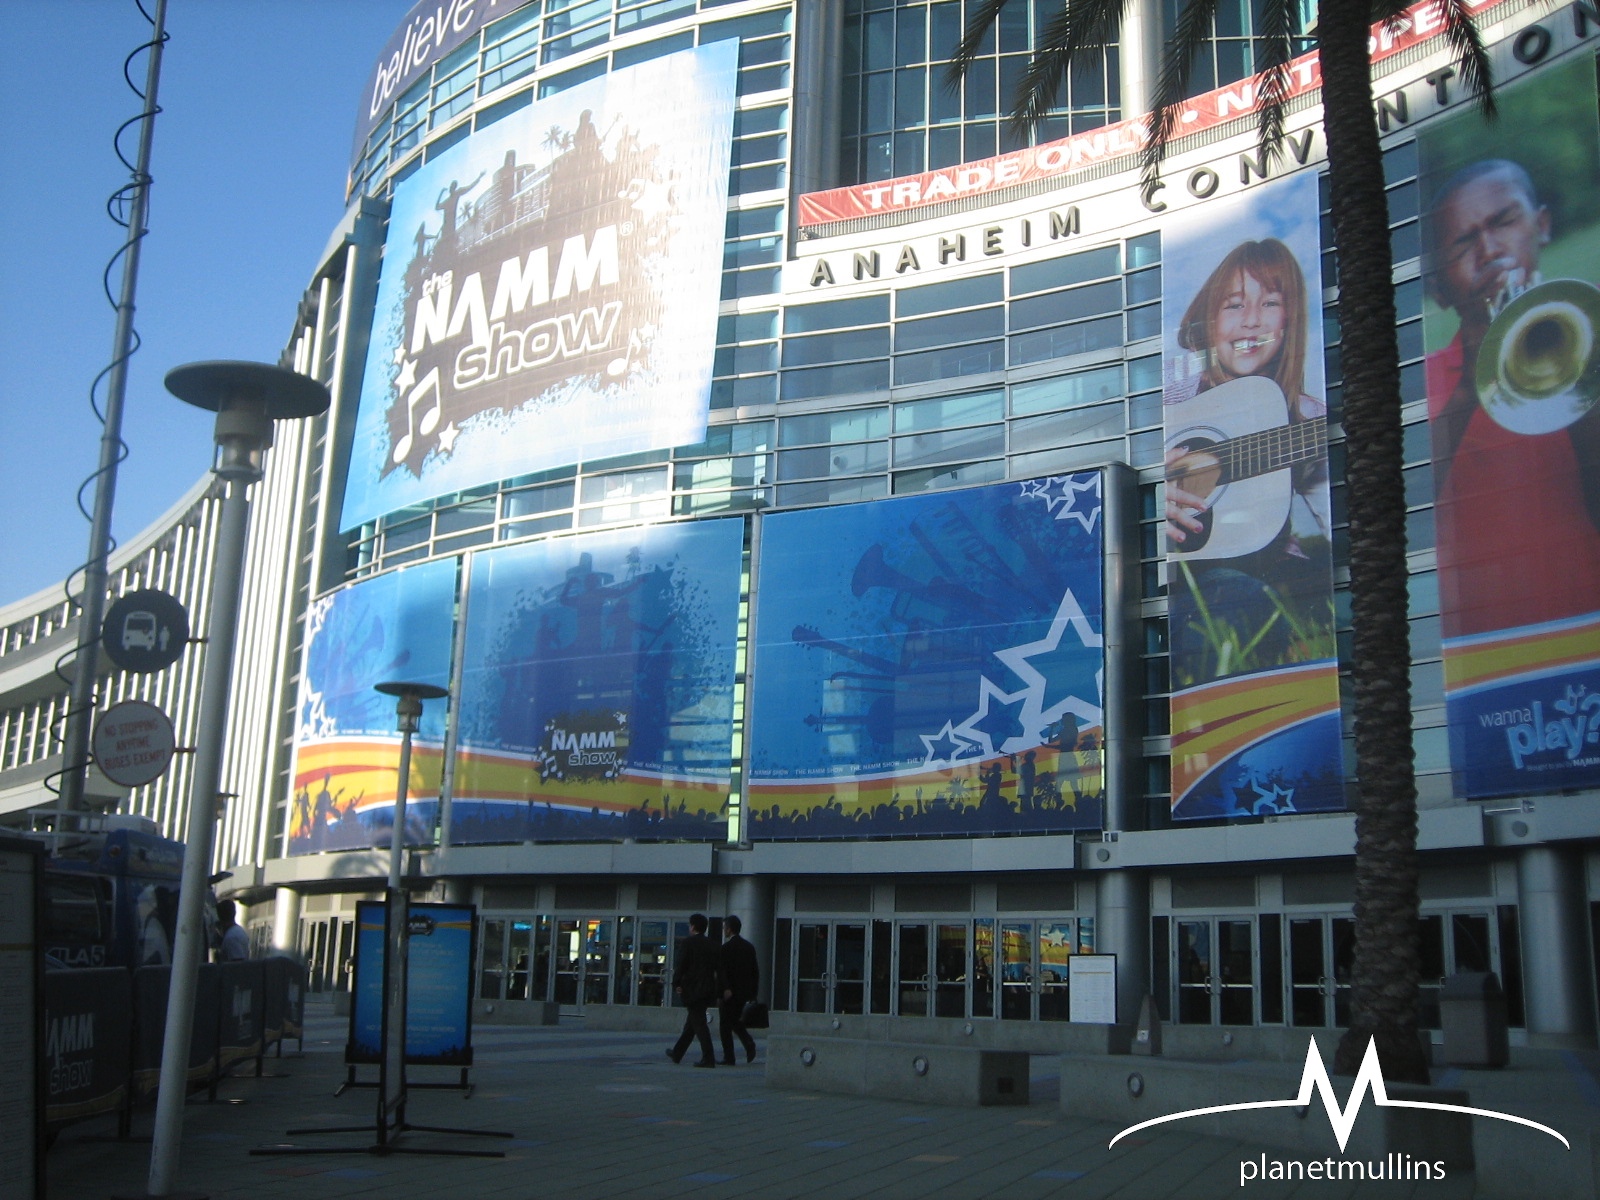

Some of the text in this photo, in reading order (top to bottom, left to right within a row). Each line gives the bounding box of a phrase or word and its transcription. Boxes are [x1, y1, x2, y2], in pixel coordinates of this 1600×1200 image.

[369, 0, 475, 120] believe
[809, 0, 1600, 287] ANAHEIM CONVNTON
[863, 157, 1022, 210] TRADE
[422, 269, 453, 298] the
[454, 301, 622, 390] show
[104, 725, 116, 737] NO
[1480, 708, 1533, 728] wanna
[551, 730, 616, 757] NAMM
[569, 750, 617, 766] show
[906, 757, 919, 765] THE
[46, 1011, 95, 1067] AMM
